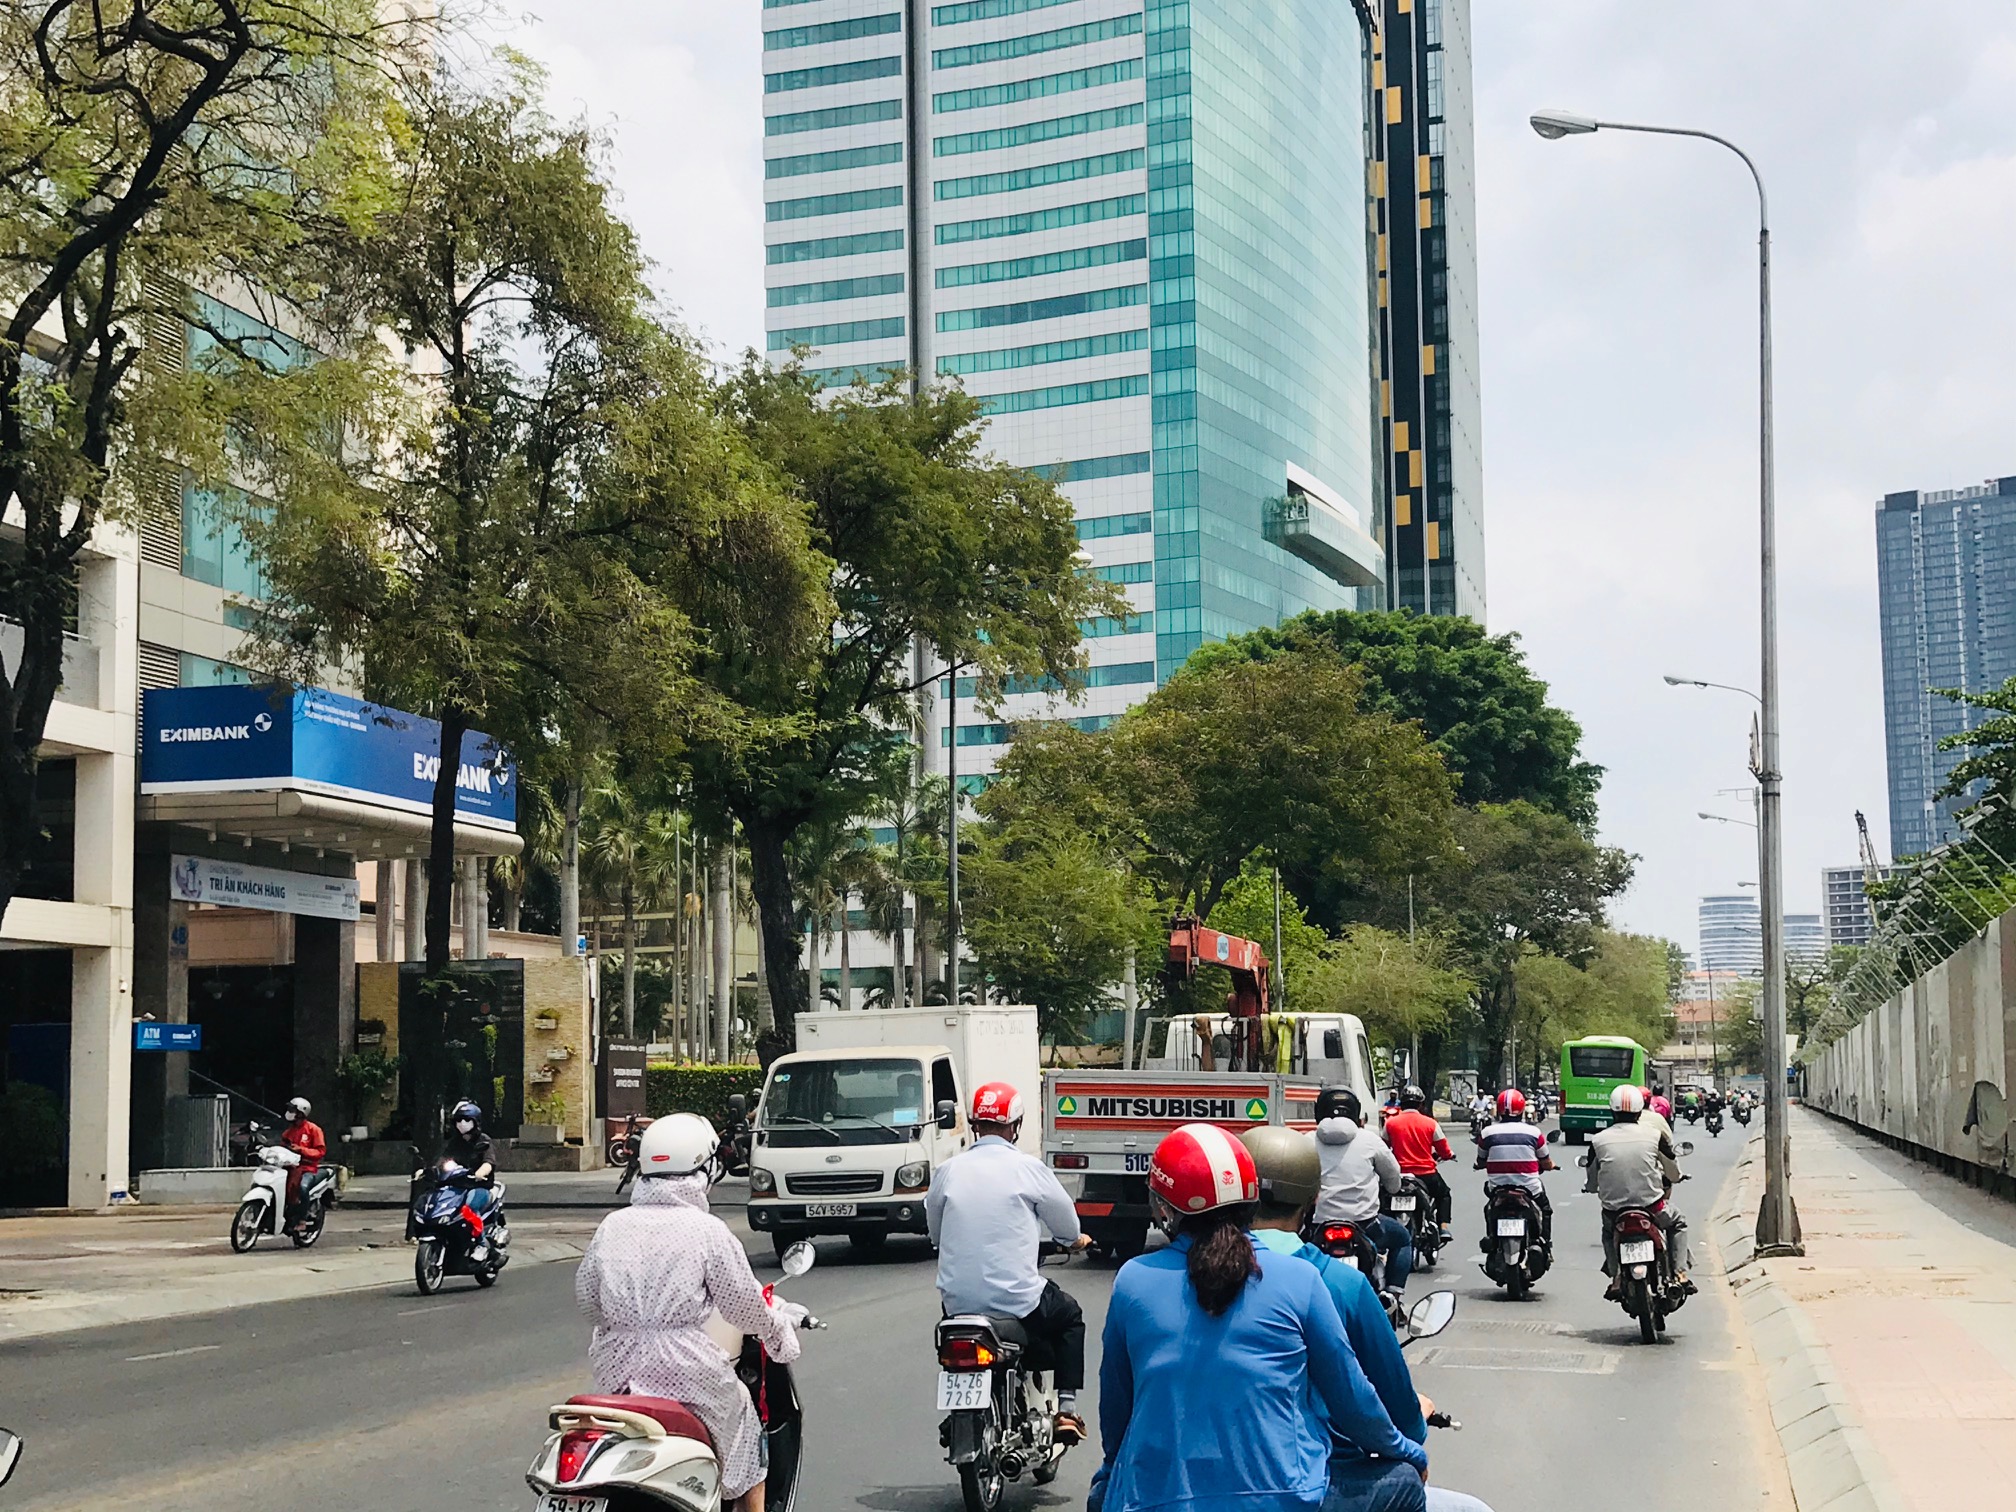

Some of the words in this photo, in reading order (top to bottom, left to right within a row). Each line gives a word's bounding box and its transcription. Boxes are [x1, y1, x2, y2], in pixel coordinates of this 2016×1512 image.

[160, 725, 250, 742] EXIMBANK
[413, 751, 491, 794] EXIANK
[209, 877, 223, 891] TRI
[224, 876, 235, 892] ÂN
[237, 880, 263, 896] KHÁCH
[264, 881, 286, 899] HÀNG
[143, 1027, 161, 1039] ATM
[1088, 1098, 1235, 1118] MITSUBISHI
[946, 1373, 983, 1389] 54-Z6
[945, 1390, 982, 1406] 7267
